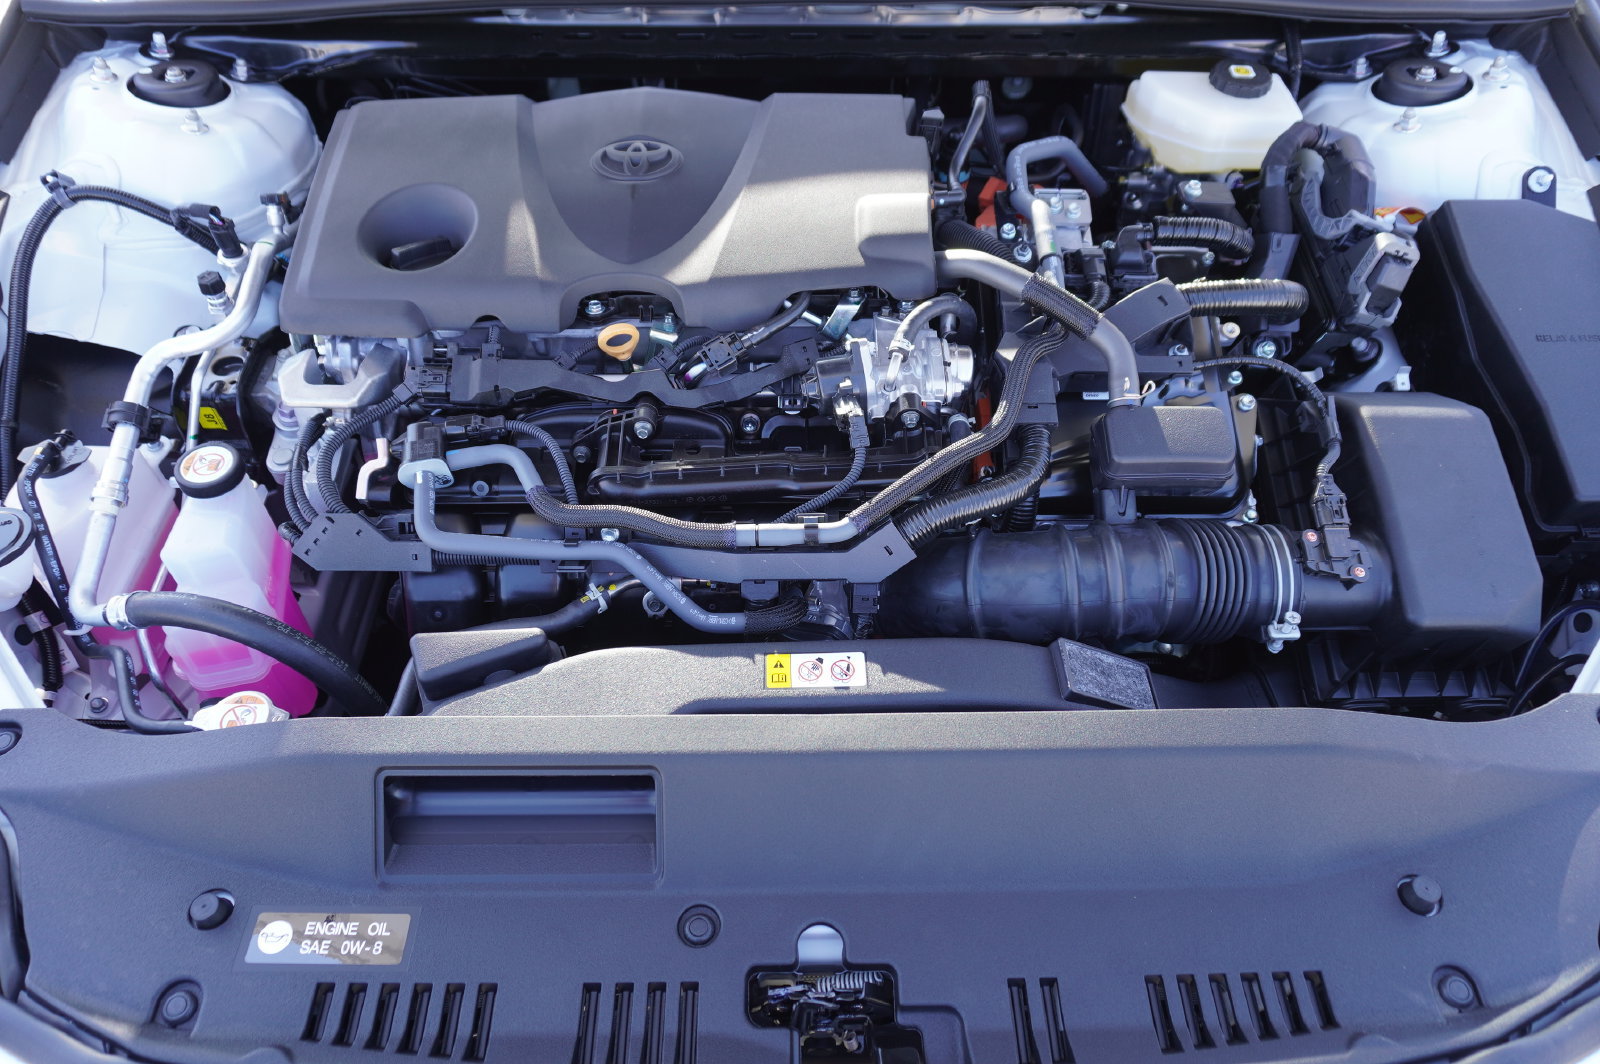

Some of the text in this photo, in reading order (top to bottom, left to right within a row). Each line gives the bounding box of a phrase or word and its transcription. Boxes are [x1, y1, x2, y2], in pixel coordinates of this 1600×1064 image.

[304, 921, 391, 936] ENGINE OIL
[299, 939, 383, 955] SAE 0W-8
